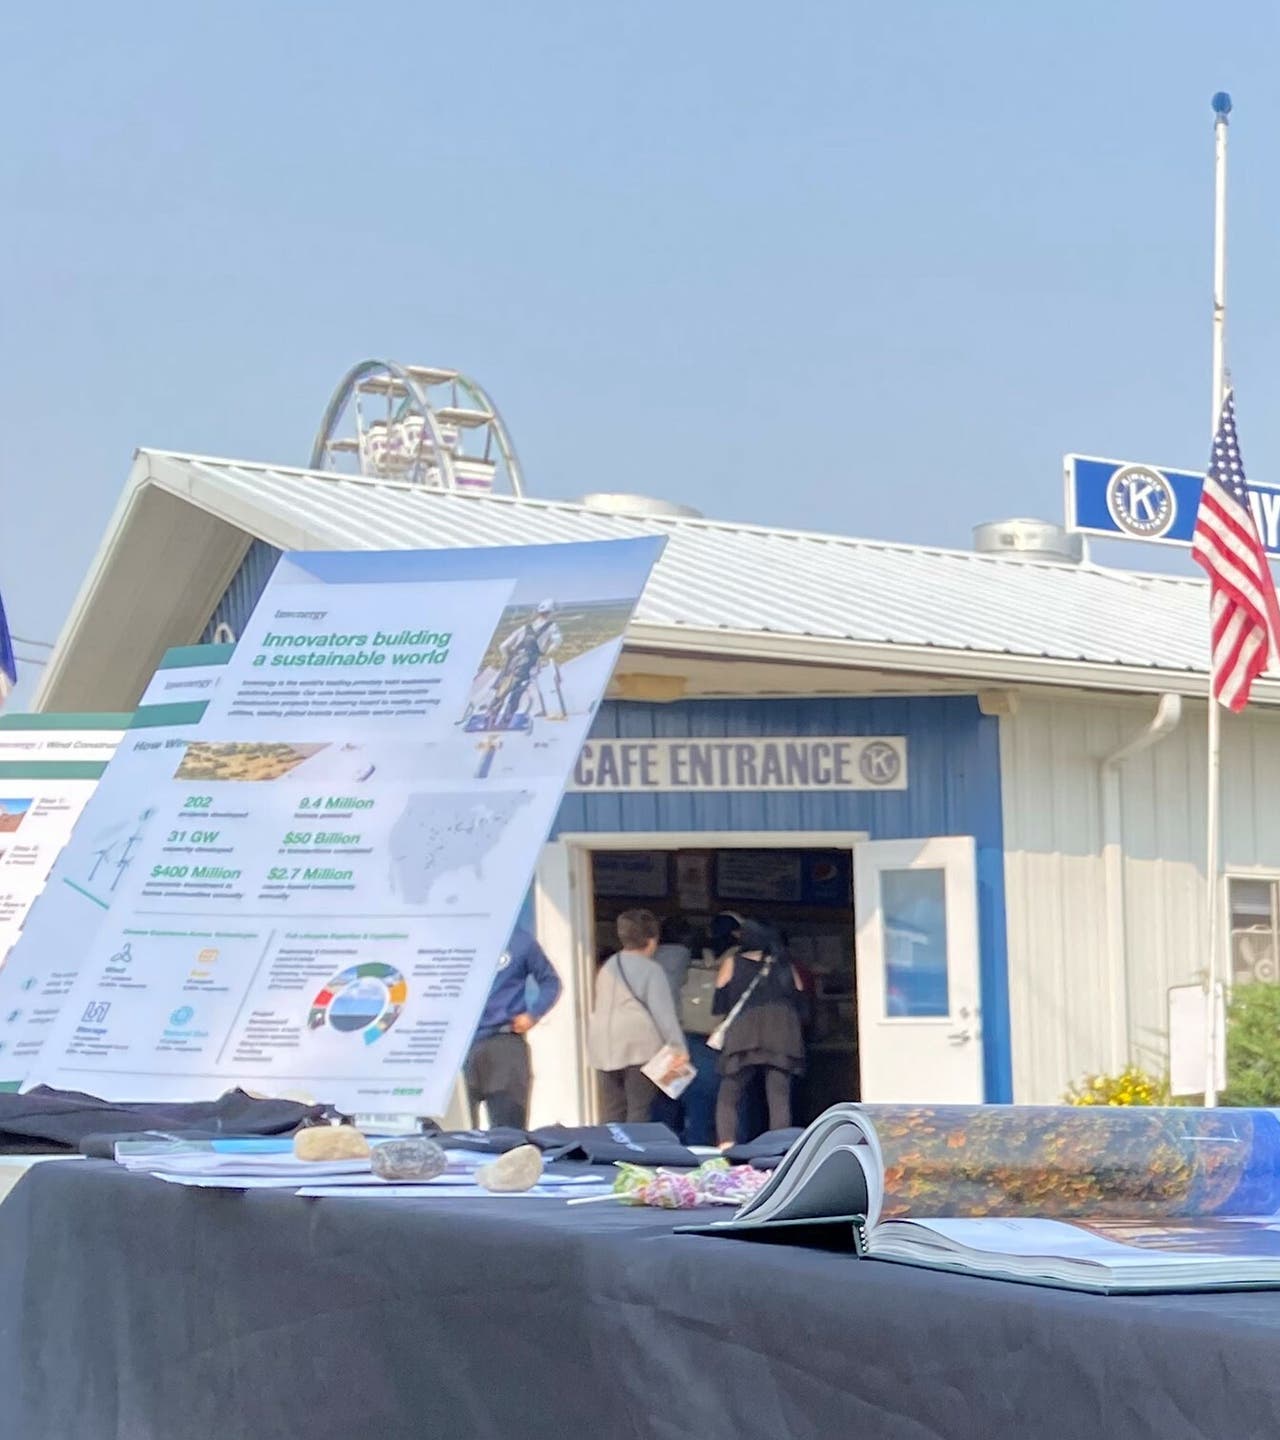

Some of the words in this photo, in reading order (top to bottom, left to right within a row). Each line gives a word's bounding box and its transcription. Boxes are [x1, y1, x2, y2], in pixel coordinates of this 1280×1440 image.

[262, 631, 368, 648] Innovators
[372, 629, 453, 648] building
[253, 655, 267, 667] a
[270, 651, 386, 666] sustainable
[391, 649, 450, 665] world
[574, 744, 659, 787] CAFE
[669, 742, 853, 787] ENTRANCE
[184, 796, 213, 809] 202
[299, 797, 322, 810] 9.4
[325, 797, 375, 810] Million
[168, 830, 186, 843] 31
[190, 830, 220, 843] GW
[283, 831, 311, 846] $50
[314, 831, 361, 845] Billion
[150, 864, 188, 879] $400
[191, 866, 242, 880] Million
[303, 868, 353, 881] Million
